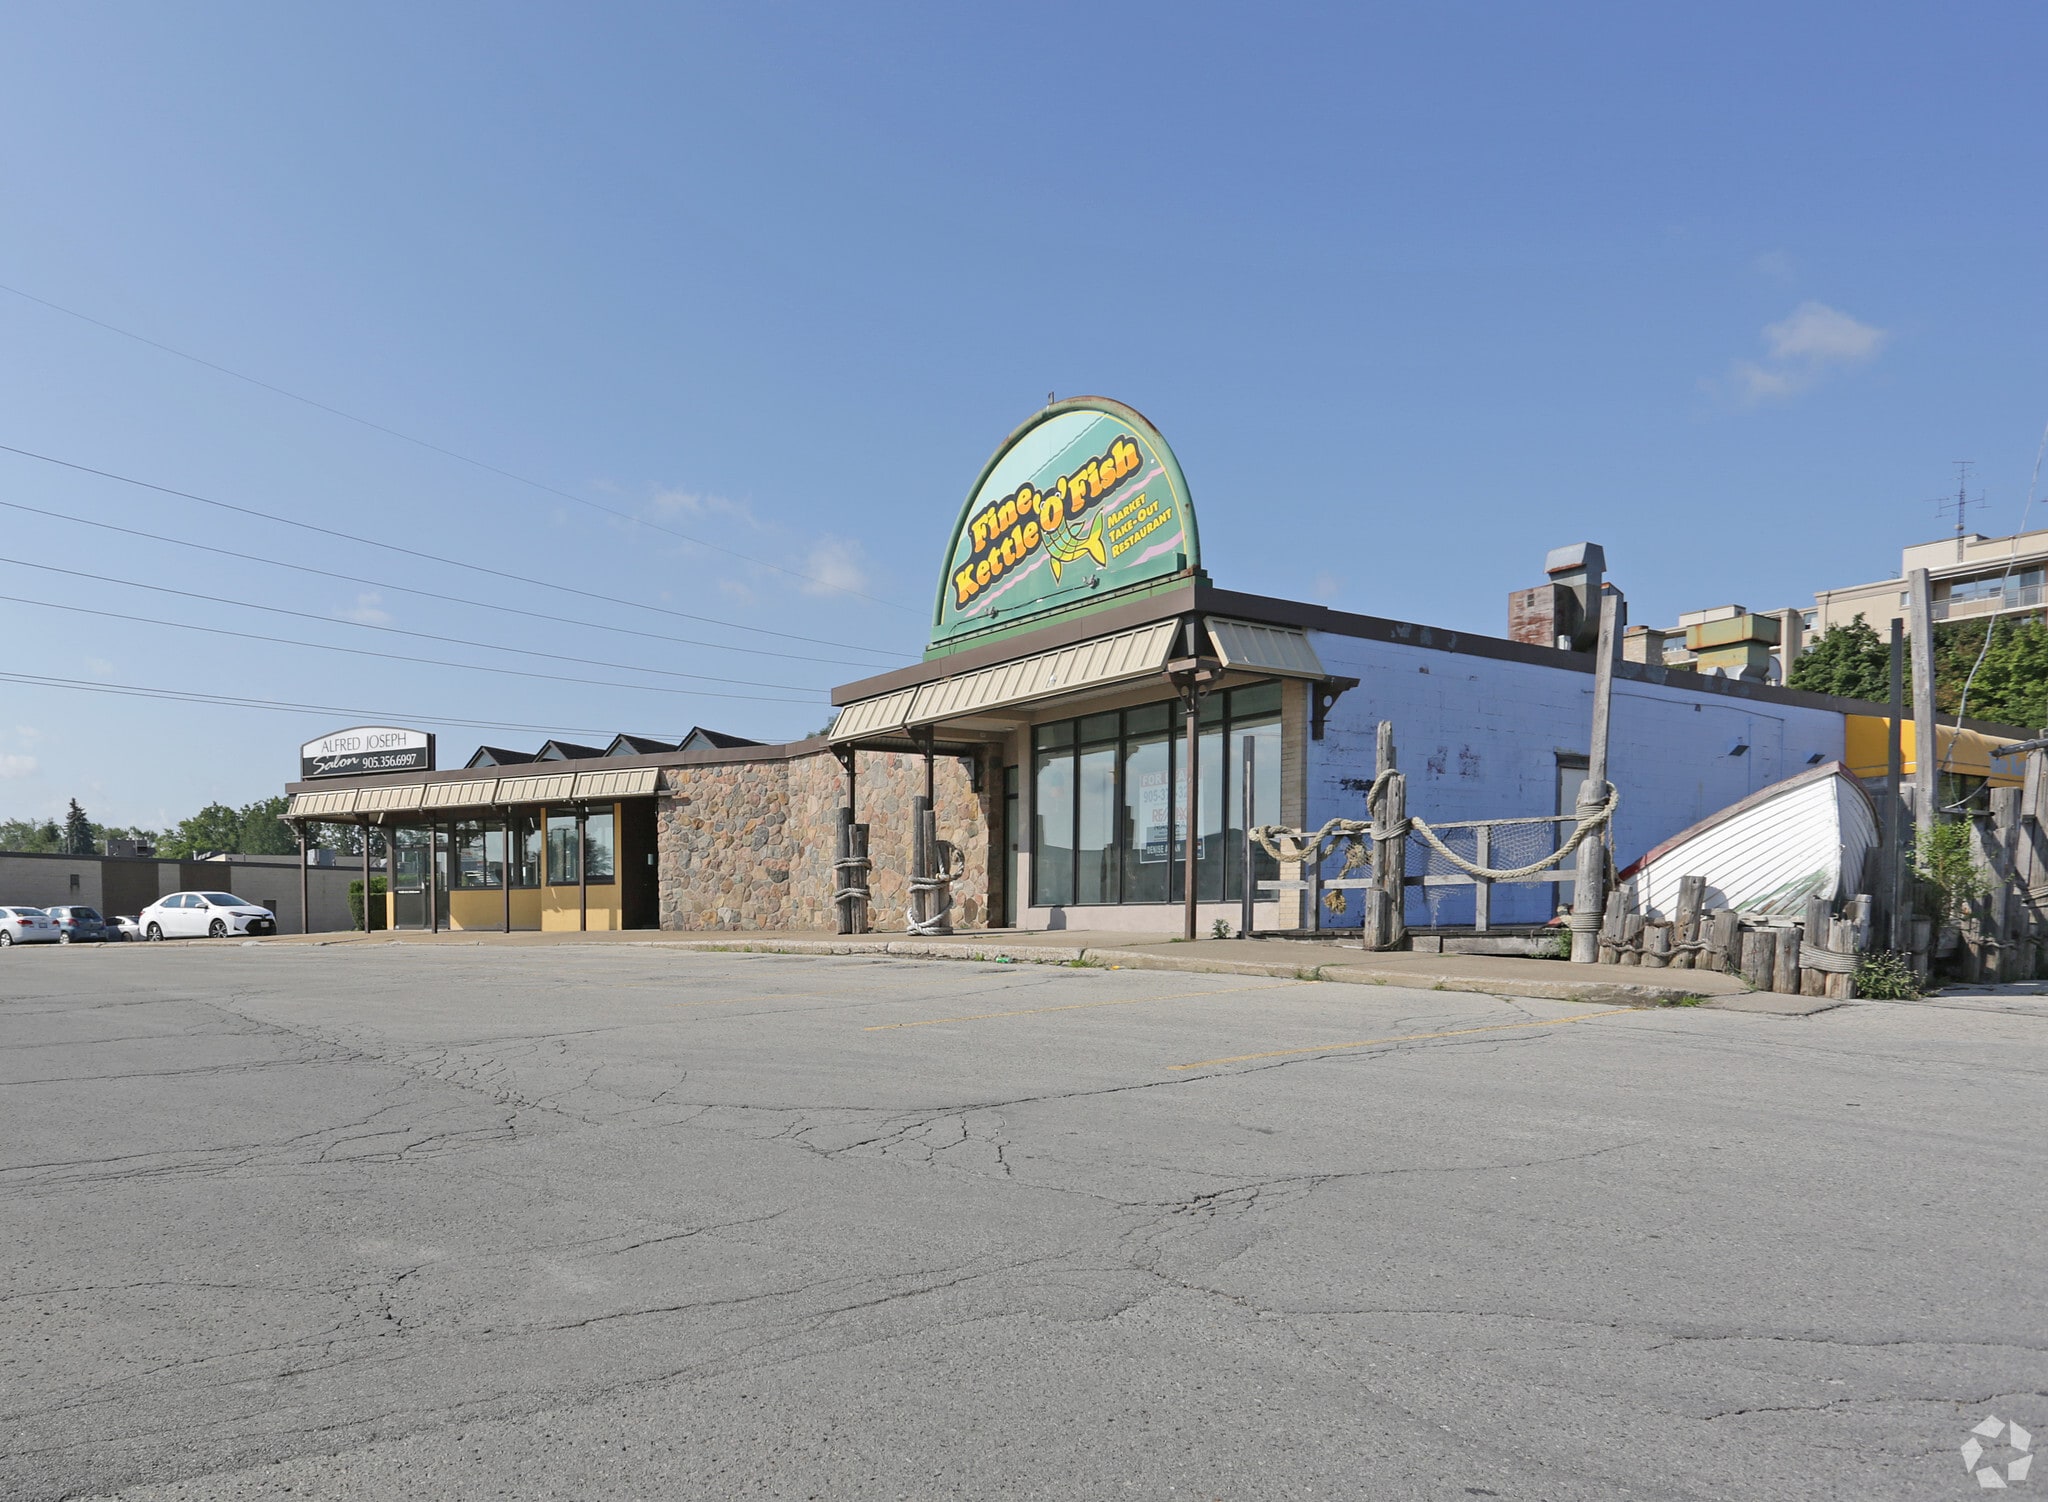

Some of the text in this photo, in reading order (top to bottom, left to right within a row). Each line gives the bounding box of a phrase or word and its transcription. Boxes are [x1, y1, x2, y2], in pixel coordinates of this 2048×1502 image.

[971, 488, 1033, 552] Fine
[1107, 493, 1146, 529] MARKET
[1108, 499, 1159, 543] TAKE-OUT
[1111, 507, 1172, 559] RESTAURANT
[954, 520, 1039, 604] Kettle
[322, 732, 407, 753] ALFRED JOSEPH
[312, 753, 417, 775] Salon 905.356.6997
[1142, 774, 1162, 786] FOR
